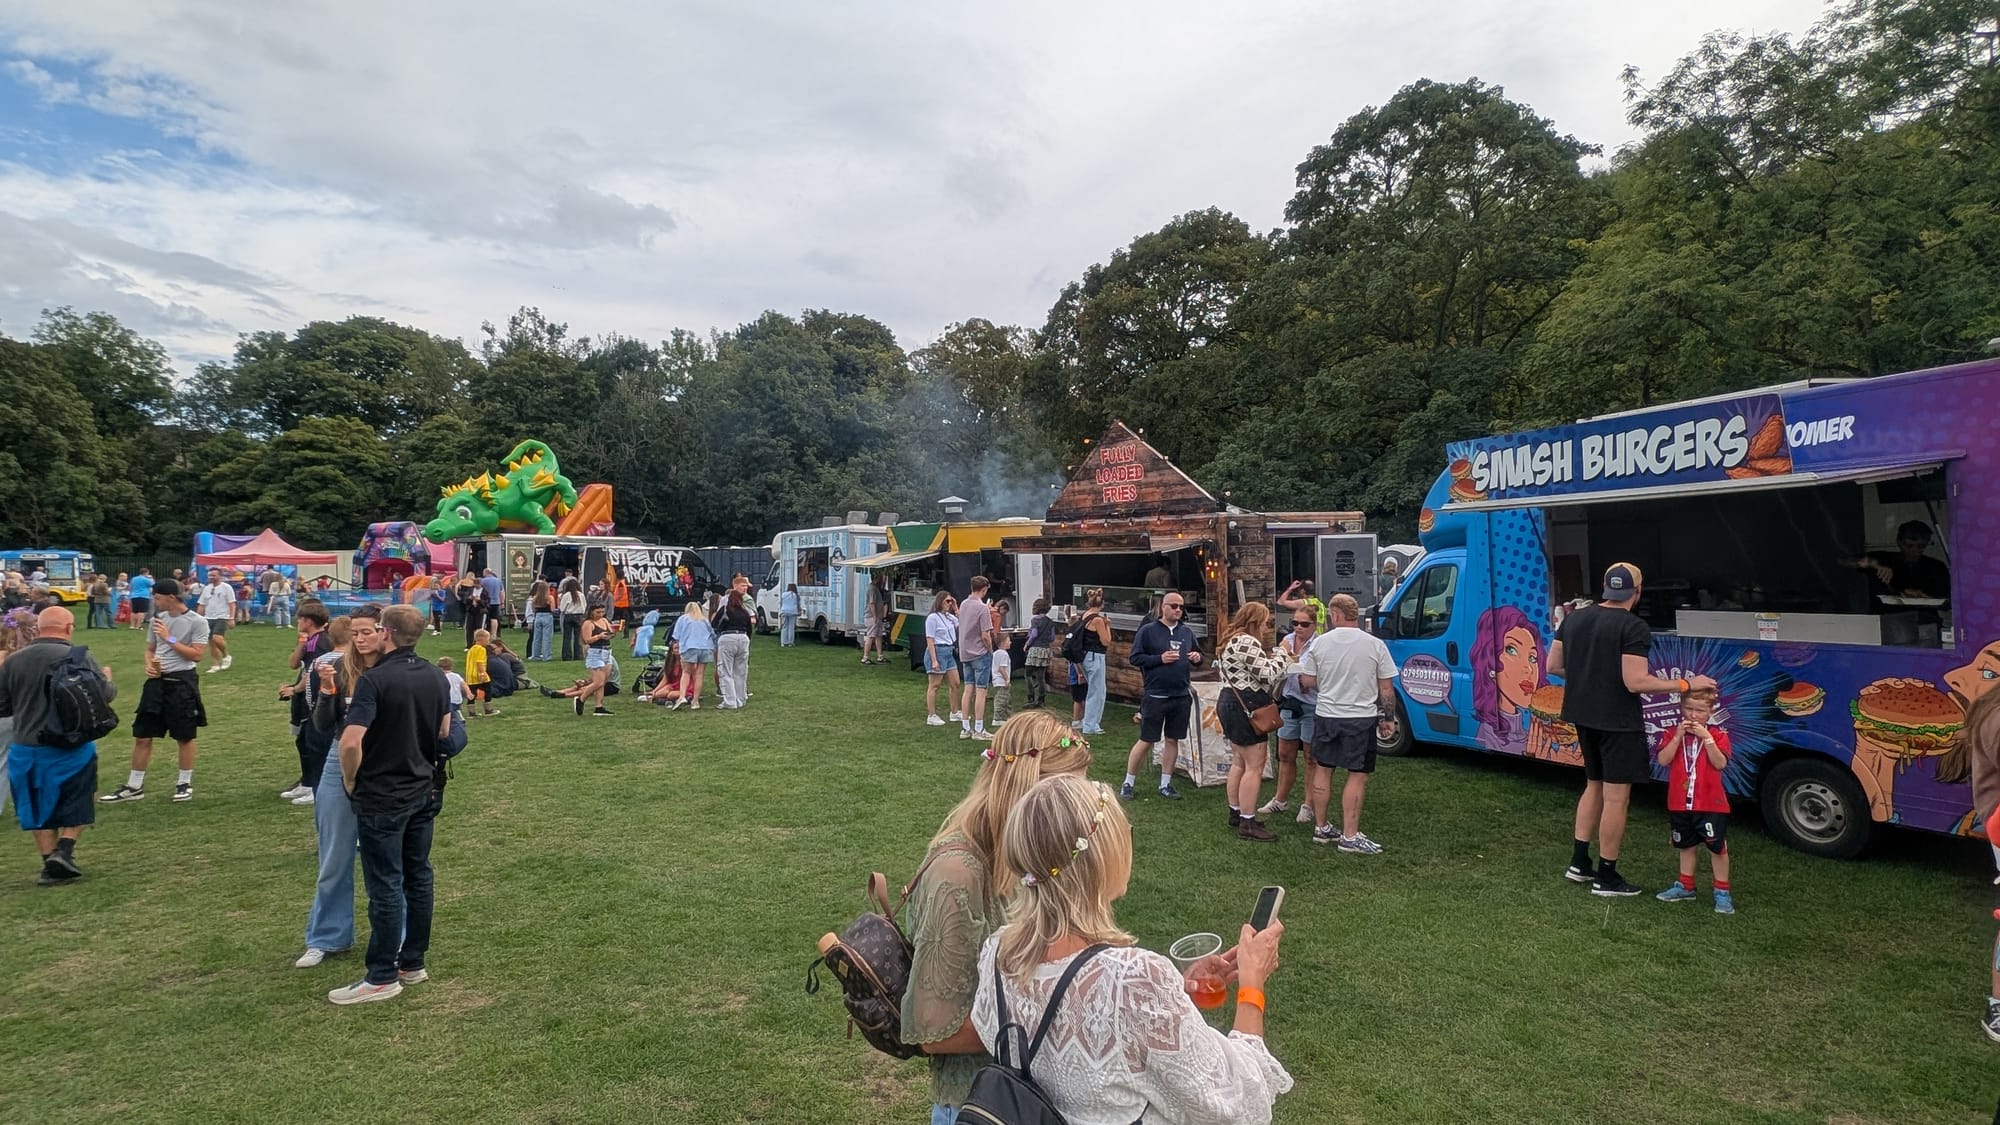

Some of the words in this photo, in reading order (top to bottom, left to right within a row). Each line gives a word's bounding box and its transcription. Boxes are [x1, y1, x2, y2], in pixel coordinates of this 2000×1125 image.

[1100, 444, 1136, 465] FULLY
[1471, 439, 1572, 492] SMASH
[1581, 415, 1748, 480] BURGERS
[1096, 464, 1144, 485] LOADED
[1103, 485, 1137, 503] FRIES
[609, 548, 655, 566] STEEL
[654, 551, 682, 566] CITY
[623, 566, 671, 584] ARCADE
[1704, 822, 1715, 838] 9
